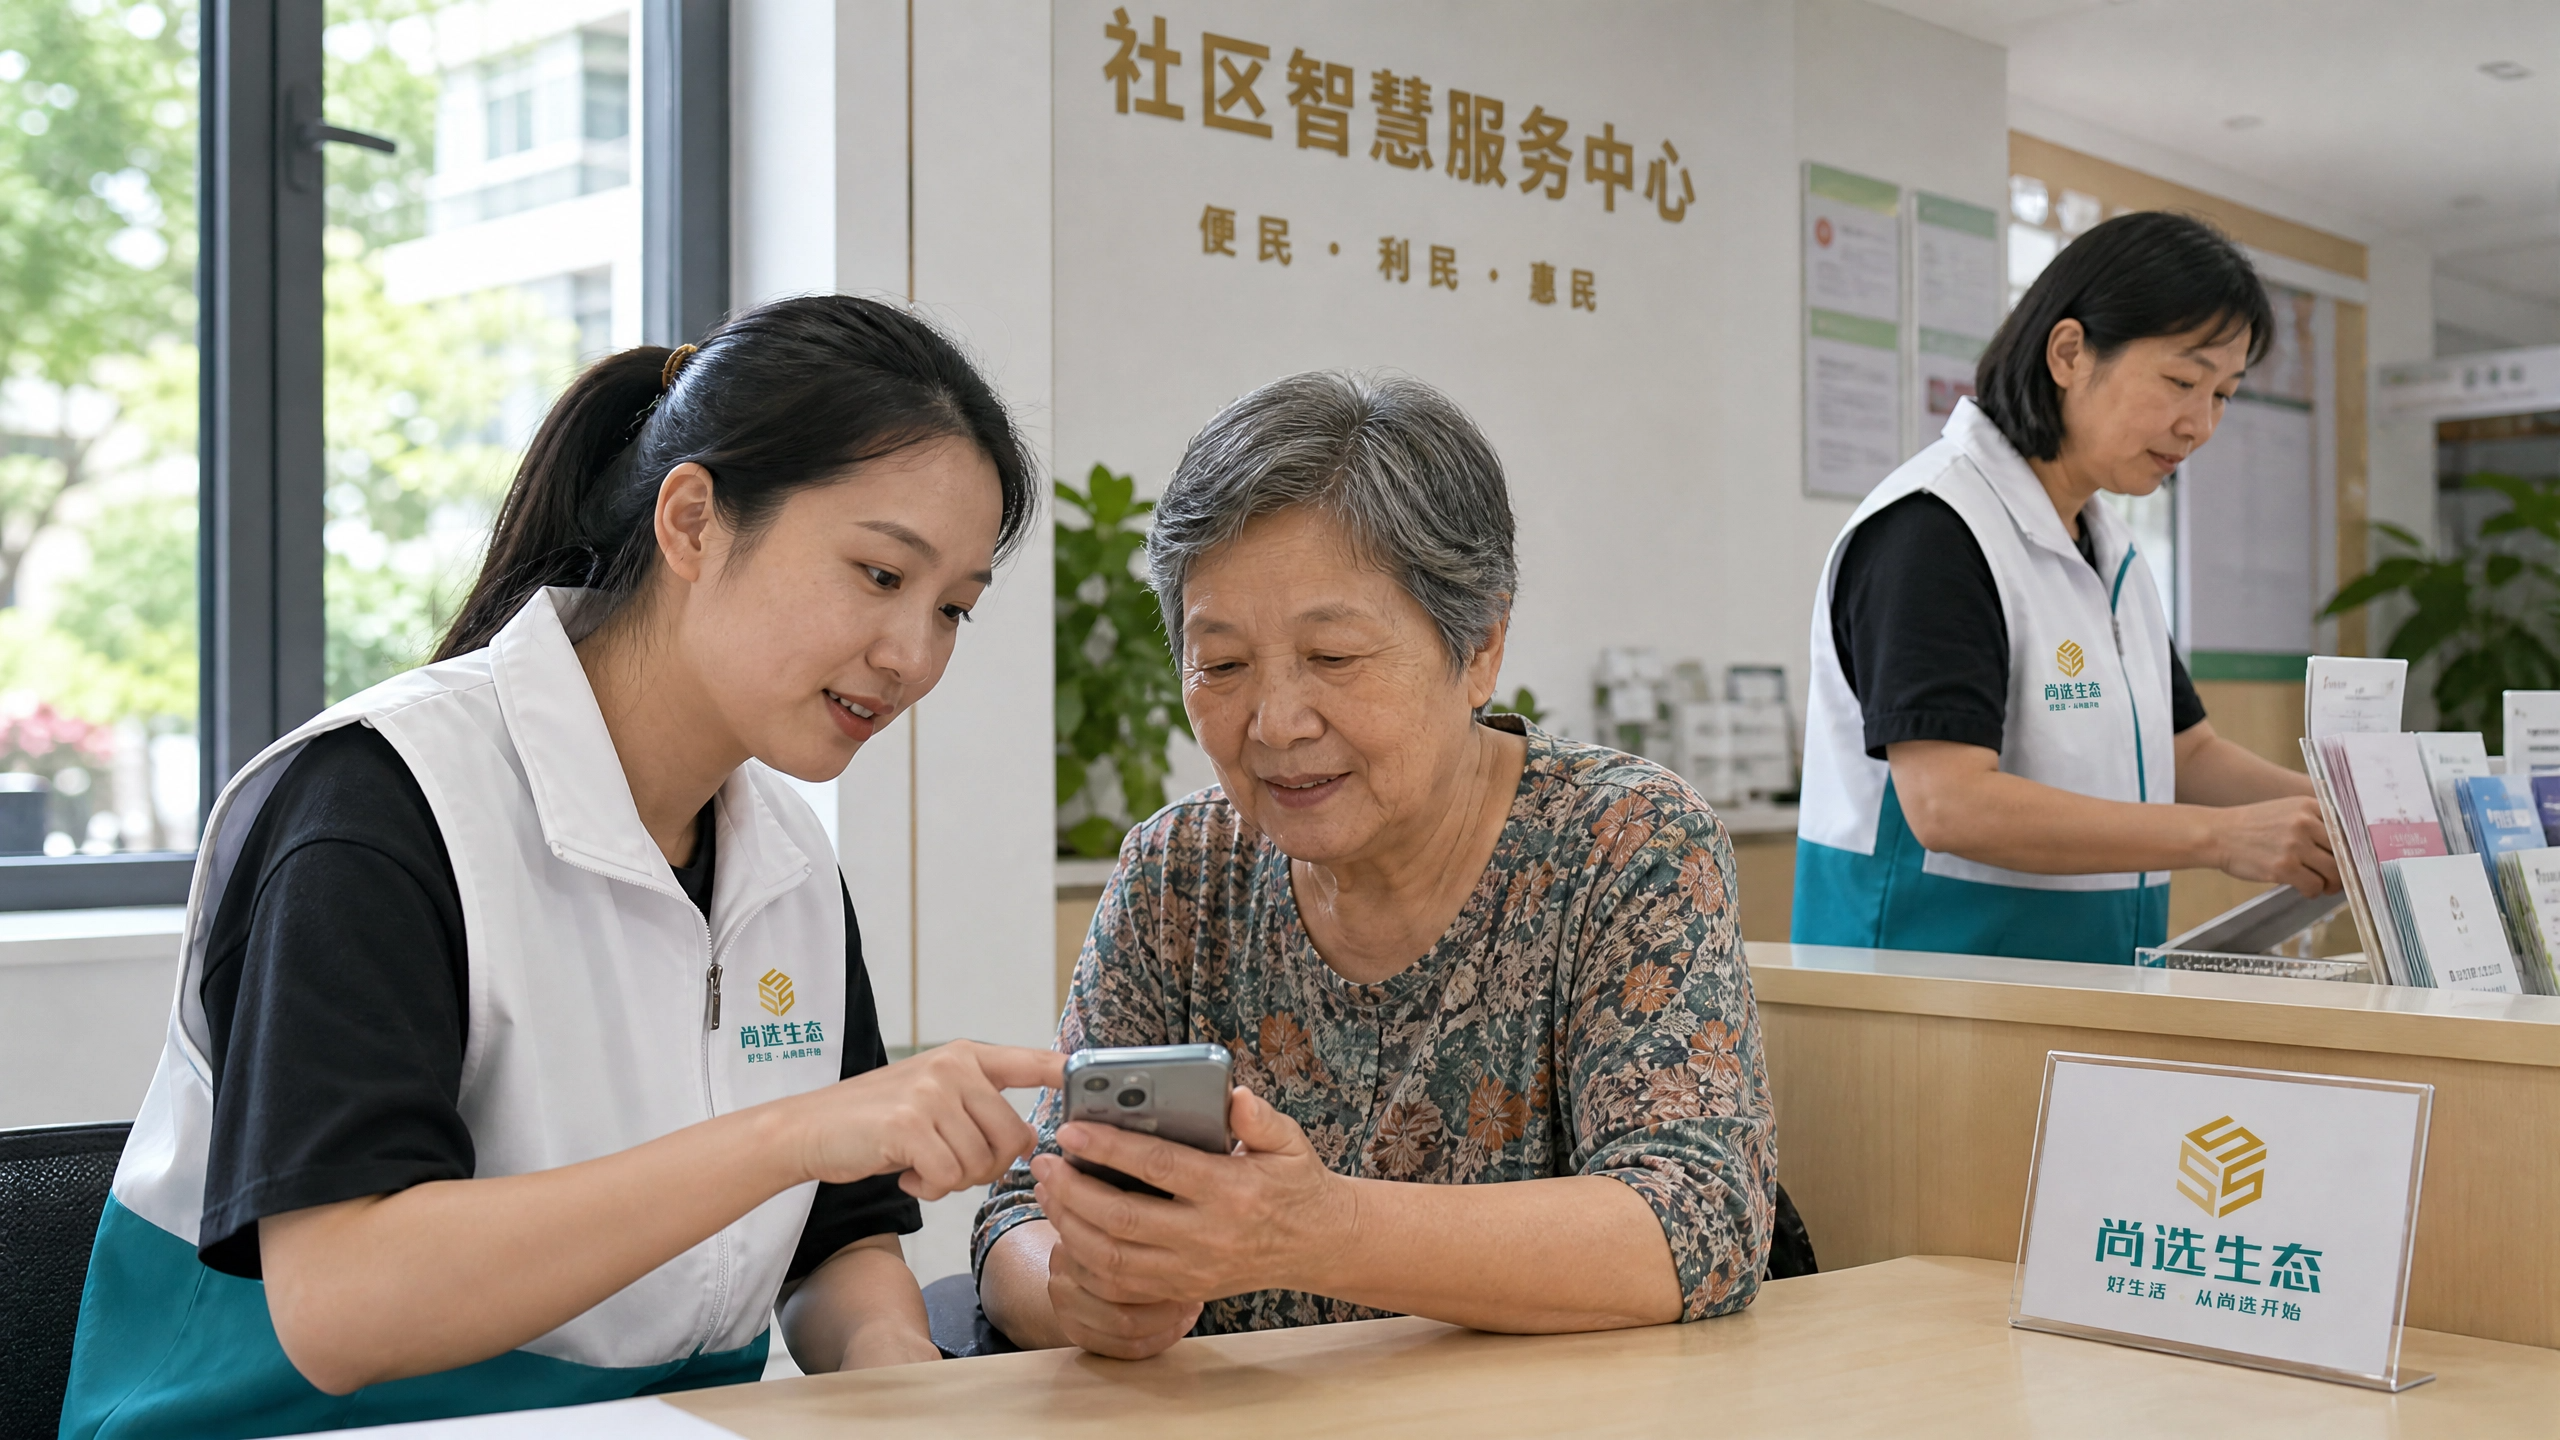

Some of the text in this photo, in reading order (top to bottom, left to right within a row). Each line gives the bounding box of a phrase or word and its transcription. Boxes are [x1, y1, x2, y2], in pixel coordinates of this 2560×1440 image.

[1103, 7, 1696, 224] 社区智慧服务中心
[1200, 204, 1597, 312] 便民 利民 惠民
[2044, 681, 2101, 701] 尚选生态
[740, 1020, 824, 1049] 尚选生态
[2094, 1217, 2324, 1294] 尚选生态
[2107, 1274, 2302, 1321] 好生活 从尚选开始
